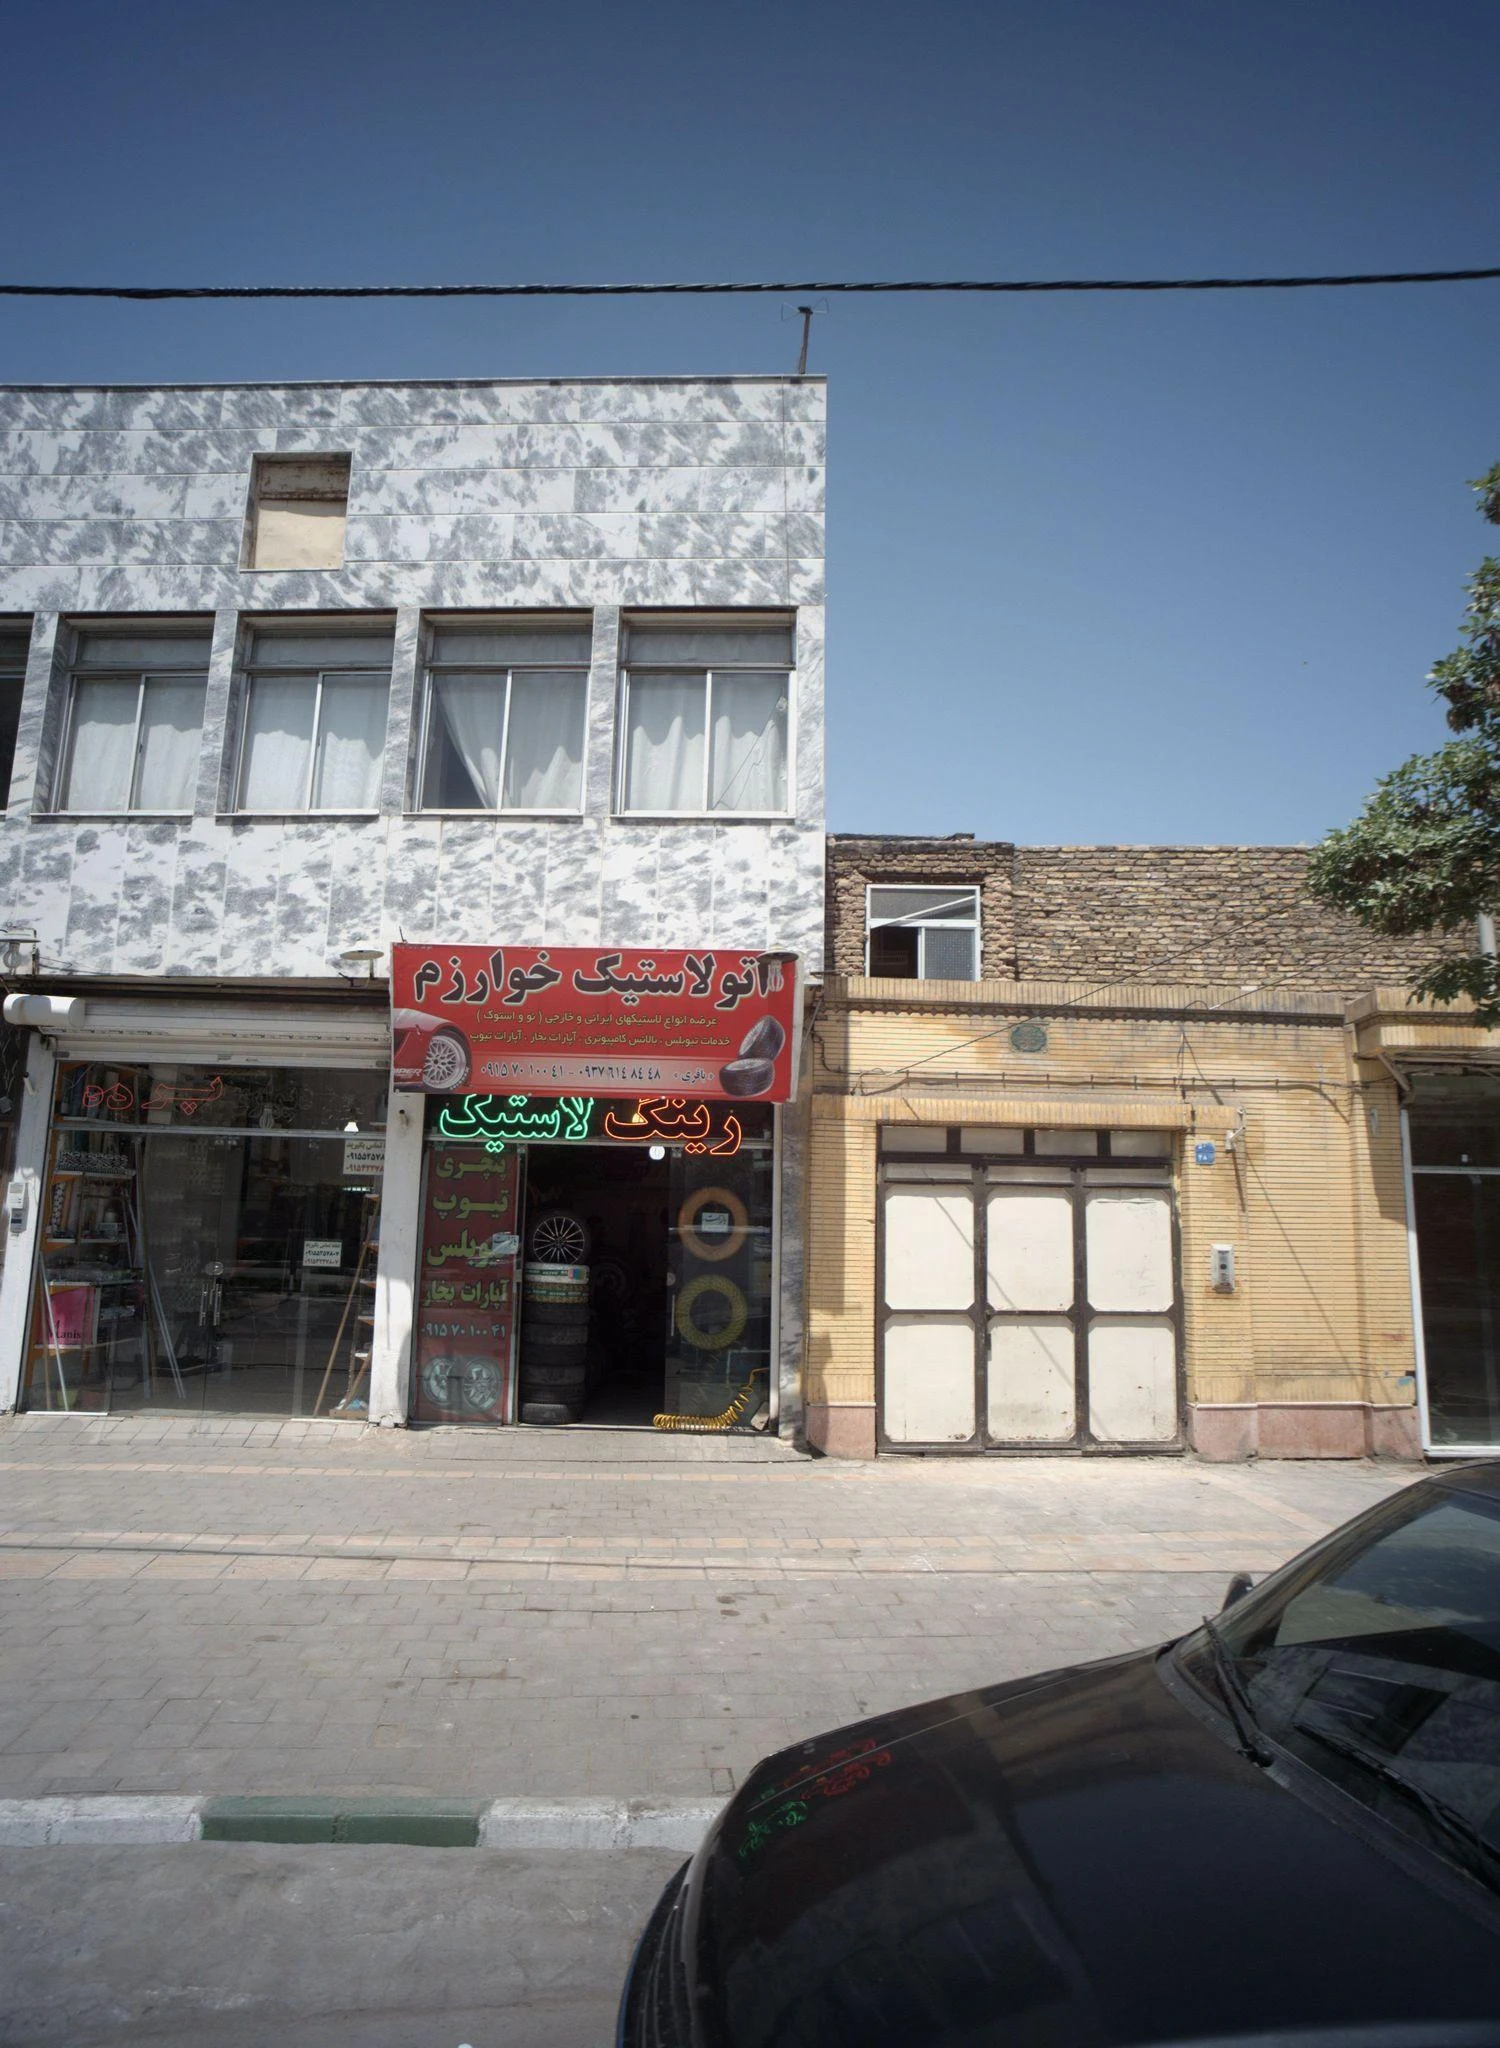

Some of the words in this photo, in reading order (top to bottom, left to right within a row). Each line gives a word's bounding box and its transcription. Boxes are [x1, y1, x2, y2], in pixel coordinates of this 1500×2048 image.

[414, 948, 562, 1006] خوارزم
[573, 951, 717, 1007] لاستیک
[714, 955, 769, 1010] اتو
[544, 1011, 574, 1025] خارجی
[576, 1014, 582, 1024] و
[584, 1013, 613, 1026] ایرانی
[663, 1015, 687, 1030] انواع
[689, 1015, 718, 1028] عرضه
[494, 1028, 522, 1044] آپارات
[530, 1030, 547, 1044] بخار
[548, 1030, 577, 1046] آپارات
[584, 1033, 627, 1047] کامپیوتری
[628, 1033, 658, 1046] بالانس
[700, 1034, 731, 1046] خدمات
[481, 1061, 509, 1077] ۰۹۱۵
[511, 1063, 524, 1076] ۷۰
[529, 1064, 548, 1077] ۱۰۰
[440, 1093, 595, 1153] لاستیک
[605, 1098, 742, 1155] رینگ
[432, 1190, 509, 1220] تیوپ
[423, 1279, 455, 1308] بخار
[460, 1279, 510, 1310] آپارات
[451, 1323, 465, 1337] ۷۰
[470, 1325, 488, 1337] ۱۰۰
